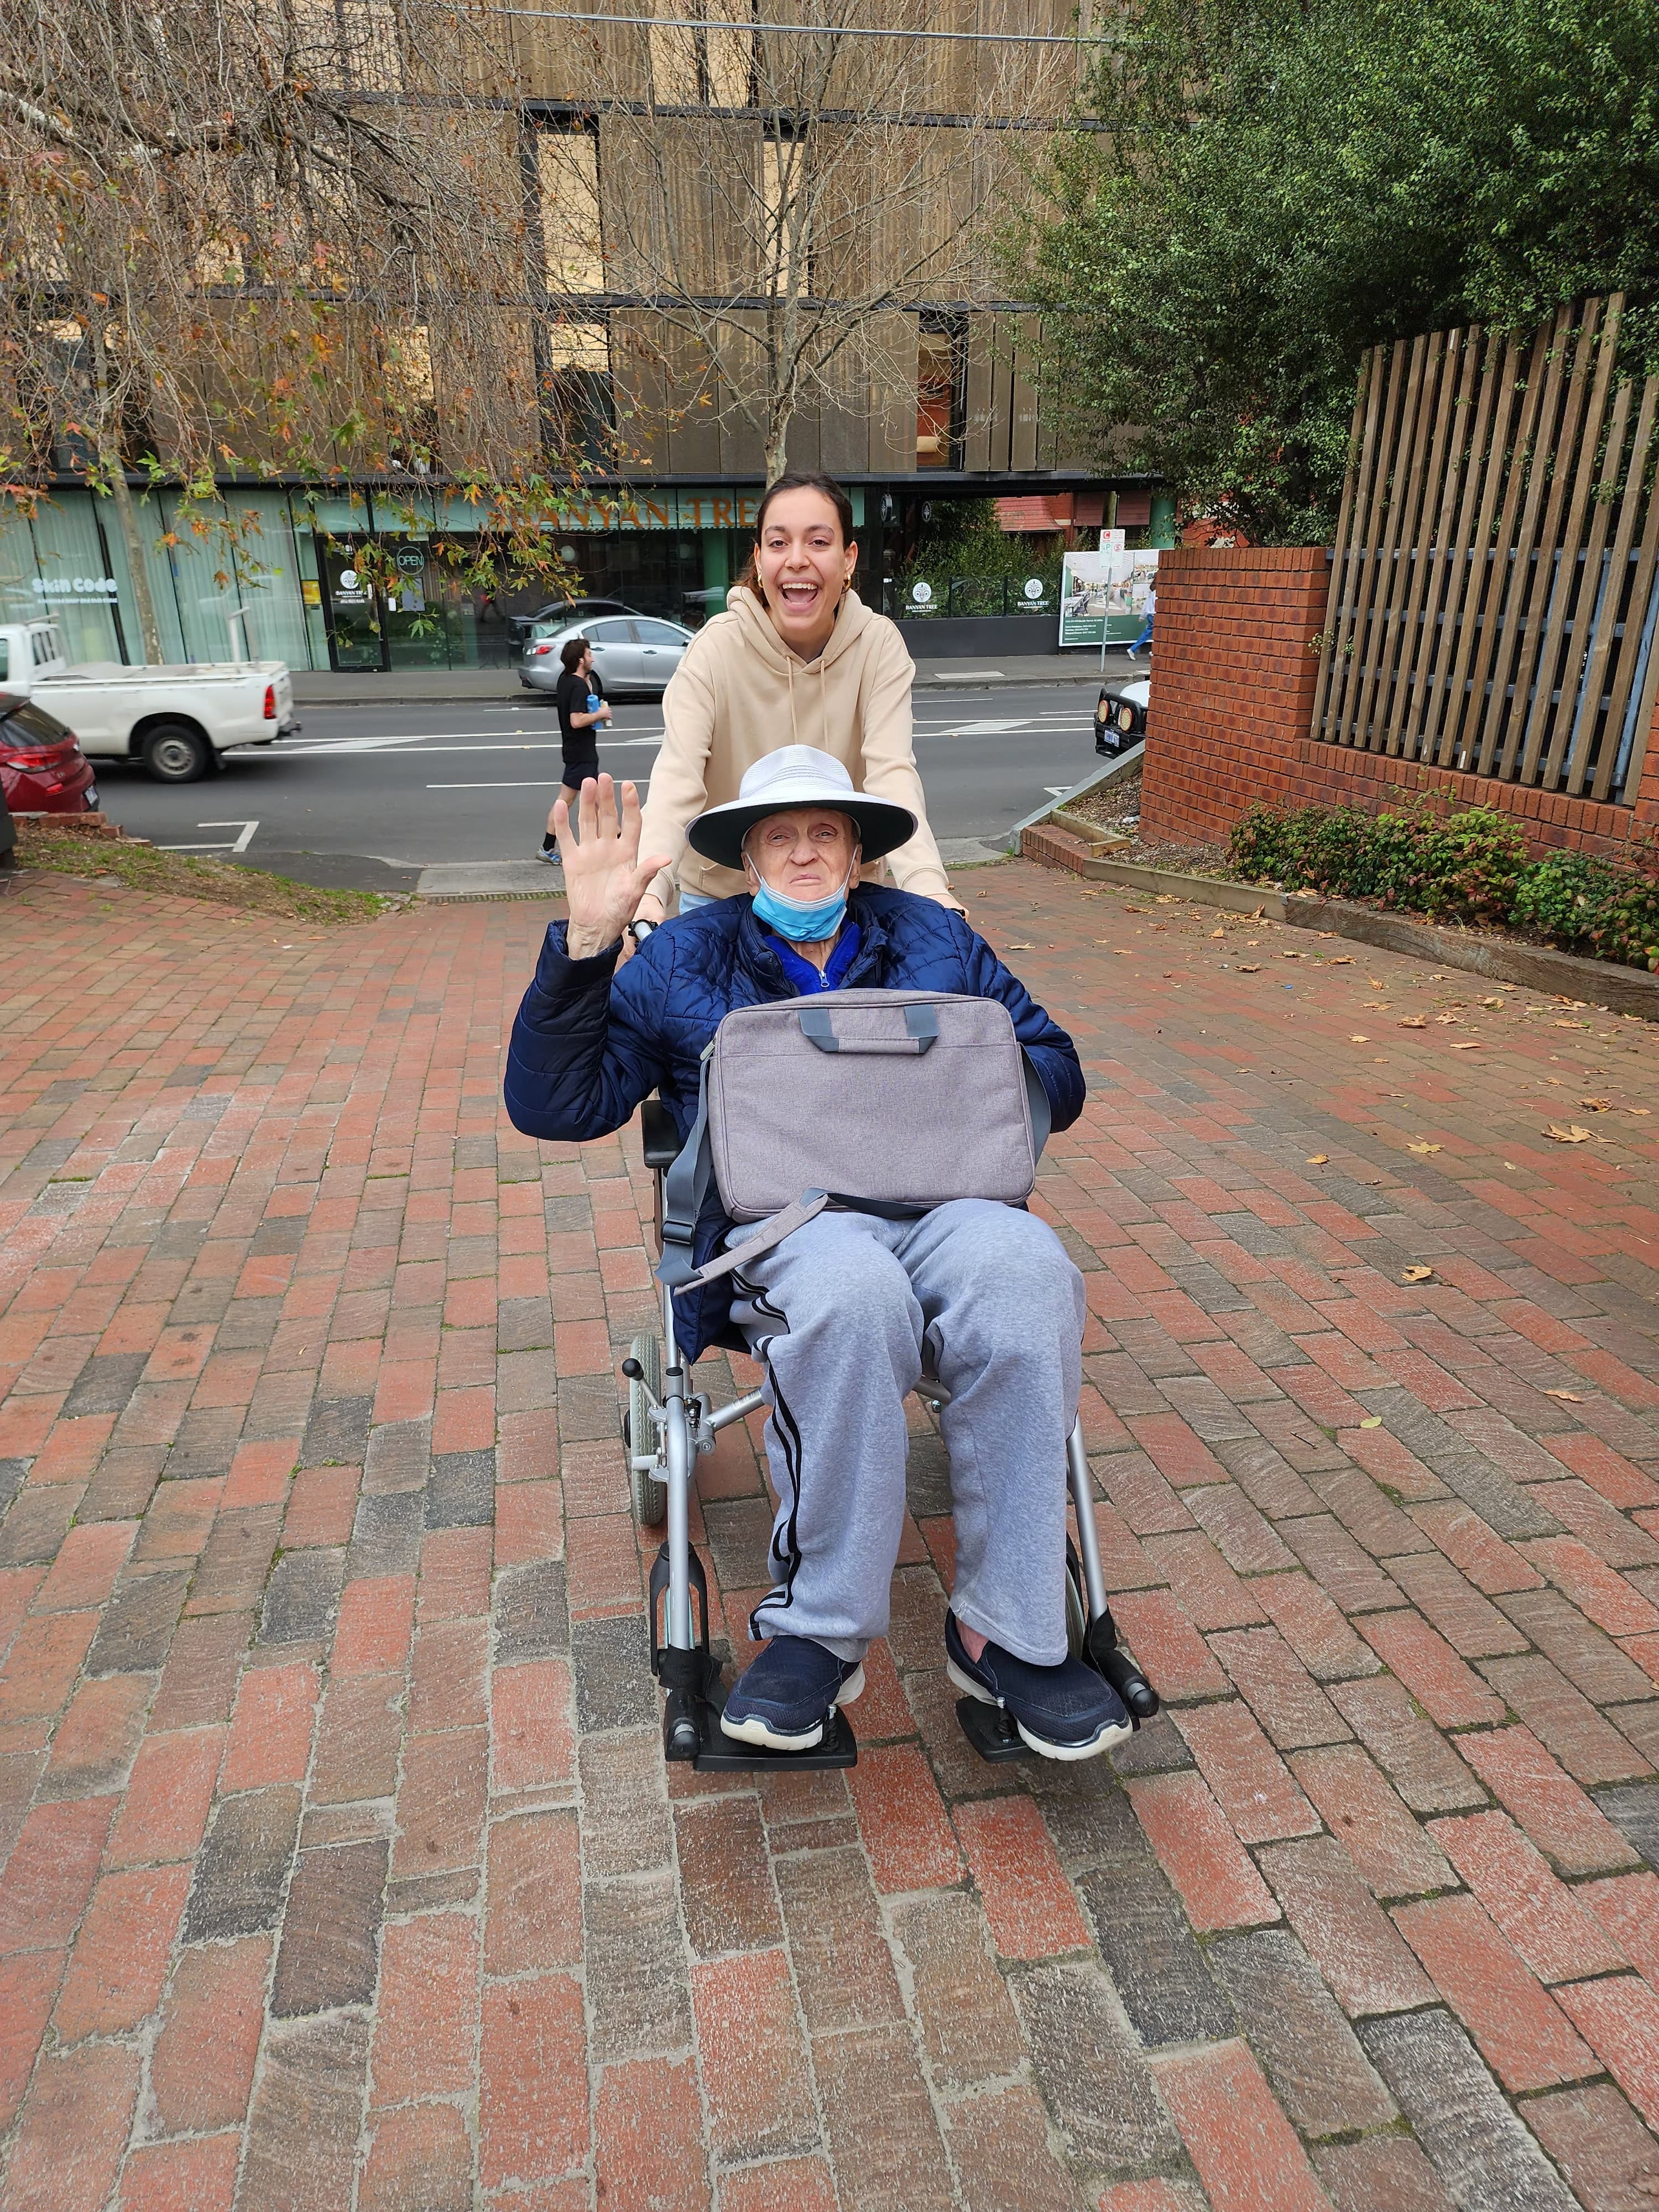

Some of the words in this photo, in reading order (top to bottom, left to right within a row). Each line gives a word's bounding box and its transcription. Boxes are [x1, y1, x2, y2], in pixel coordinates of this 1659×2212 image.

[538, 498, 669, 529] ANYAN
[686, 498, 756, 528] TRE
[398, 556, 423, 566] OPEN
[32, 577, 71, 593] Skin
